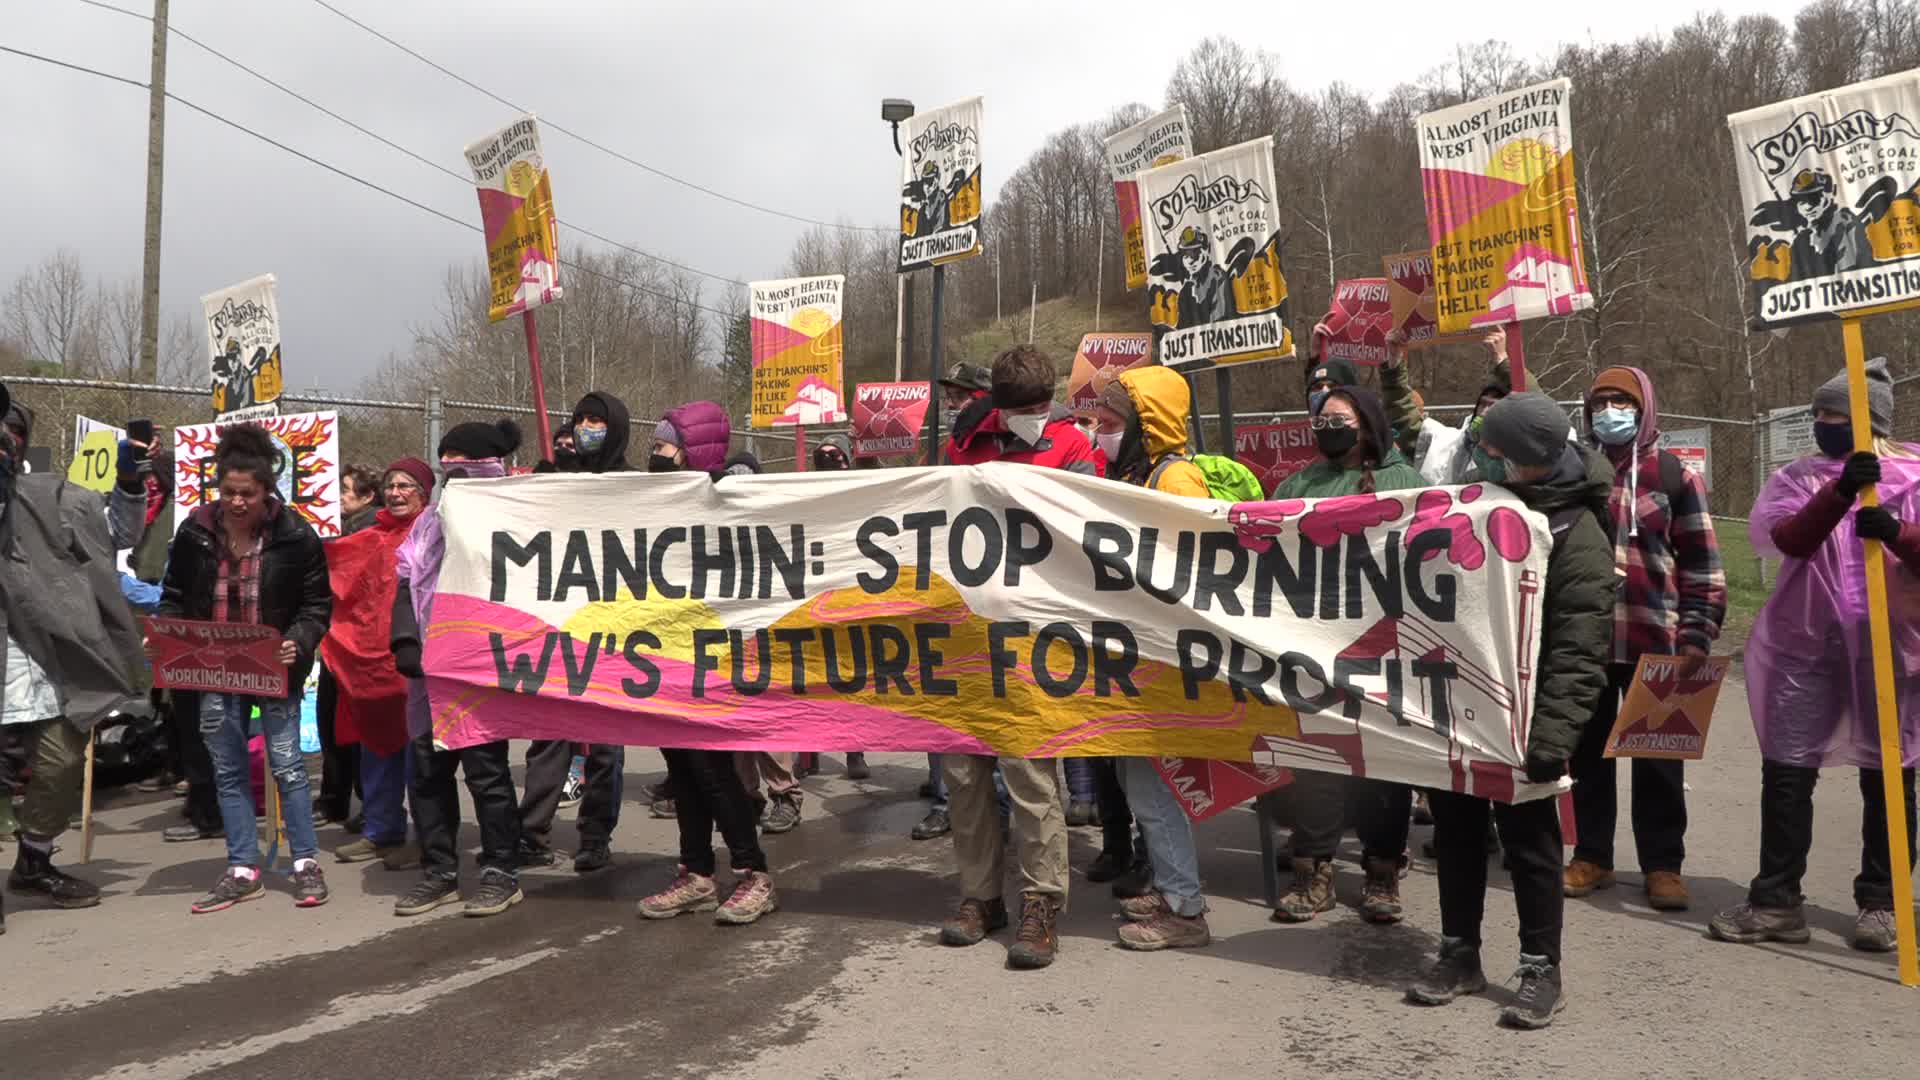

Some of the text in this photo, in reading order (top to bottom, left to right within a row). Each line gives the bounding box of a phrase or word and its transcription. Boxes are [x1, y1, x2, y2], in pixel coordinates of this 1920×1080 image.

[1426, 89, 1564, 140] ALMOST HEAVEN
[501, 119, 535, 149] HEAVEN
[914, 126, 968, 163] SOLIDARITY
[1113, 121, 1184, 165] ALMOST HEAVEN
[1430, 110, 1559, 160] WEST VIRGINIA
[1764, 115, 1895, 175] SOLIDARITY
[498, 138, 536, 169] VIRGINIA
[1116, 135, 1184, 176] WEST VIRGINIA
[1840, 148, 1917, 172] ALL COAL
[1845, 143, 1870, 155] WITH
[1844, 161, 1915, 183] WORKERS
[1159, 180, 1250, 231] SOLIDARITY
[1217, 204, 1234, 216] WITH
[1213, 208, 1268, 233] ALL COAL
[1215, 223, 1266, 243] WORKERS
[1437, 223, 1553, 259] BUT MANCHIN'S
[903, 230, 972, 262] JUST TRANSITION
[1391, 262, 1410, 279] WV
[1437, 255, 1494, 276] MAKING
[755, 279, 839, 302] ALMOST HEAVEN
[1338, 285, 1389, 302] WV RISI
[1438, 274, 1489, 297] IT LIKE
[1768, 268, 1920, 315] JUST TRANSITIO
[757, 293, 836, 313] WEST VIRGINIA
[1440, 296, 1487, 316] HELL
[1083, 338, 1147, 354] WV RISING
[1164, 320, 1278, 360] JUST TRANSITION
[755, 364, 828, 378] BUT MANCHIN'S
[755, 379, 790, 389] MAKING
[857, 385, 928, 401] WV RISING
[755, 391, 786, 402] IT LIKE
[1079, 396, 1097, 410] JUST
[755, 404, 783, 416] HELL
[1235, 428, 1312, 452] WV RISI
[82, 448, 109, 480] TO
[489, 506, 1456, 622] MANCHIN: STOP BURNING
[151, 622, 273, 638] WV RISING
[161, 668, 283, 692] WORKING FAMILIES
[488, 620, 1459, 737] WV'S FUTURE FOR PROFIT
[1642, 661, 1672, 682] WV
